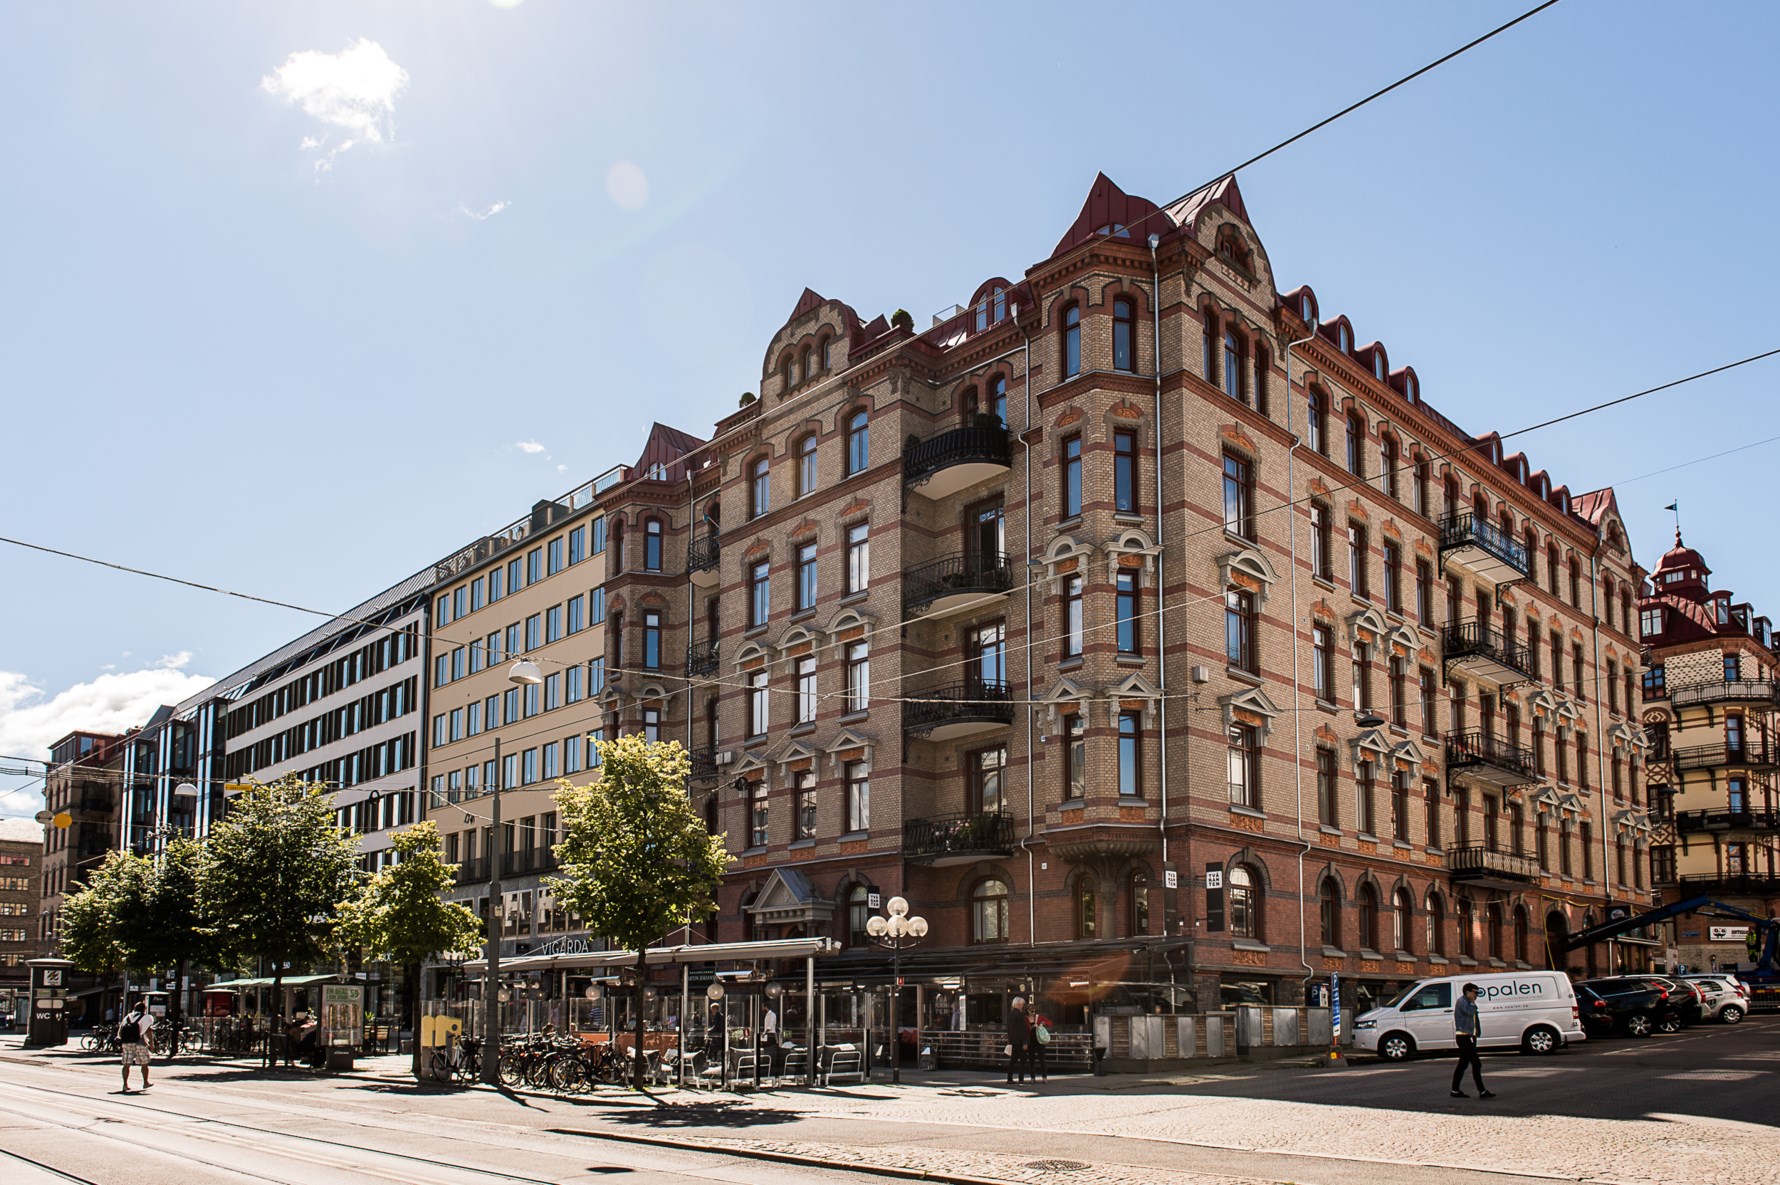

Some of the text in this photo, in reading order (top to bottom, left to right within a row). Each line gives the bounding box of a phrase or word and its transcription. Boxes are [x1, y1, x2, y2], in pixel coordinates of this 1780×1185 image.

[1311, 989, 1318, 998] P
[1477, 980, 1542, 1001] opalen
[36, 1012, 51, 1020] WC
